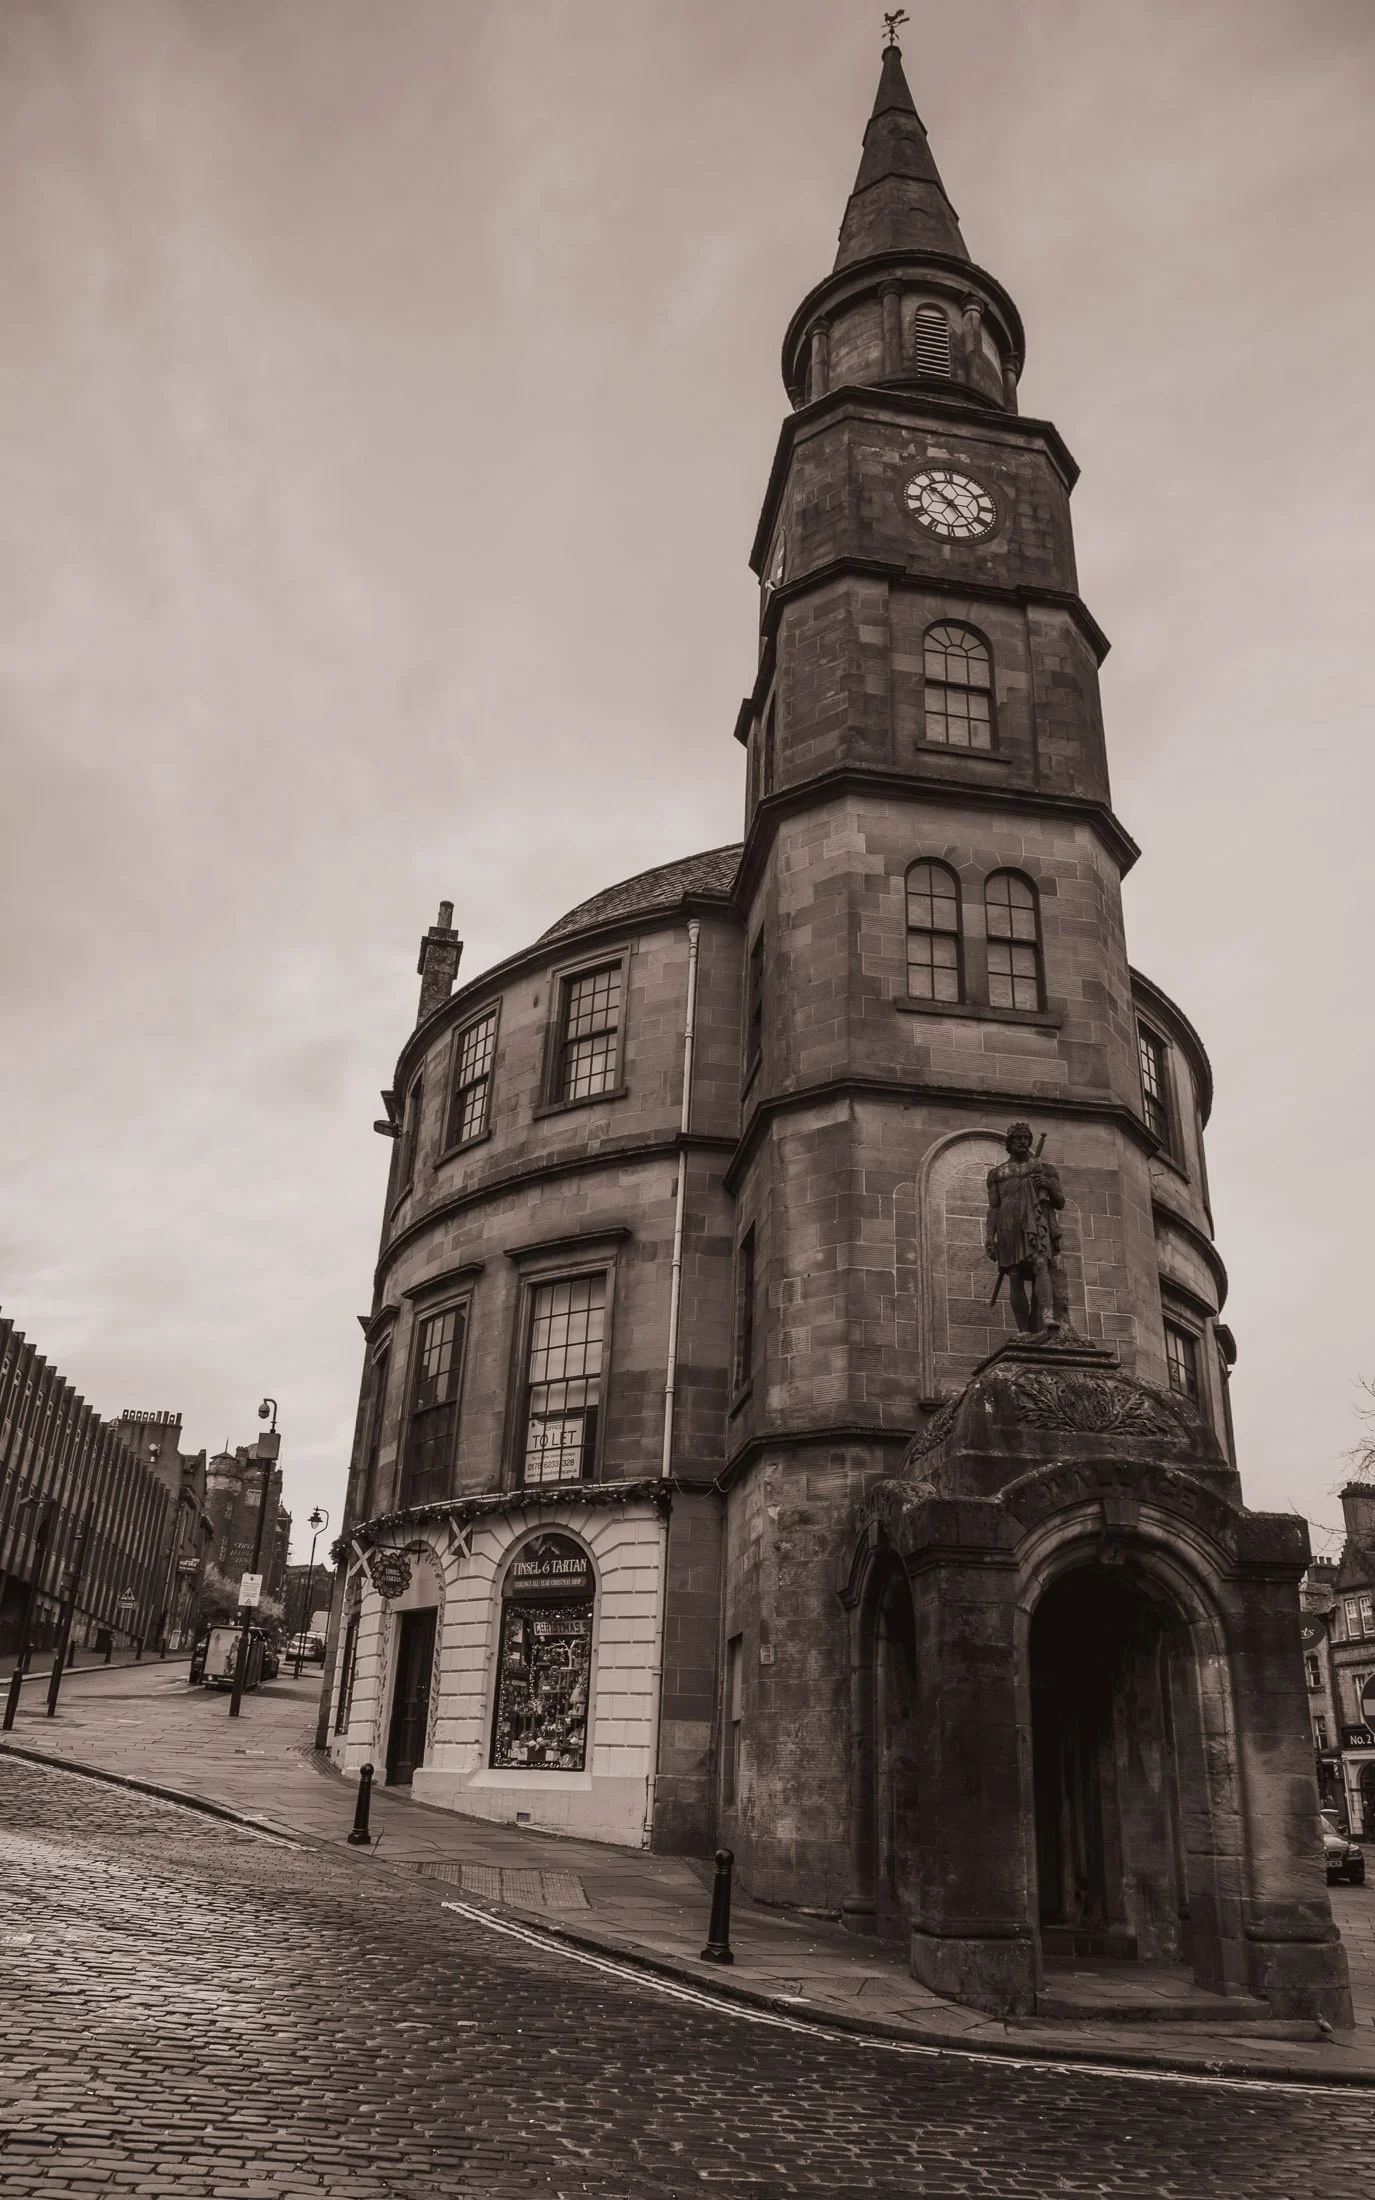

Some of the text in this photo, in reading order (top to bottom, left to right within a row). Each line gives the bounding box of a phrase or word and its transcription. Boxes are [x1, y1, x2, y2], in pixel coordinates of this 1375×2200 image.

[532, 1430, 577, 1449] TO LET
[1038, 1468, 1201, 1514] WALLACE
[513, 1559, 587, 1575] TINSEL & TARTAN
[535, 1621, 580, 1633] CHRISTMAS
